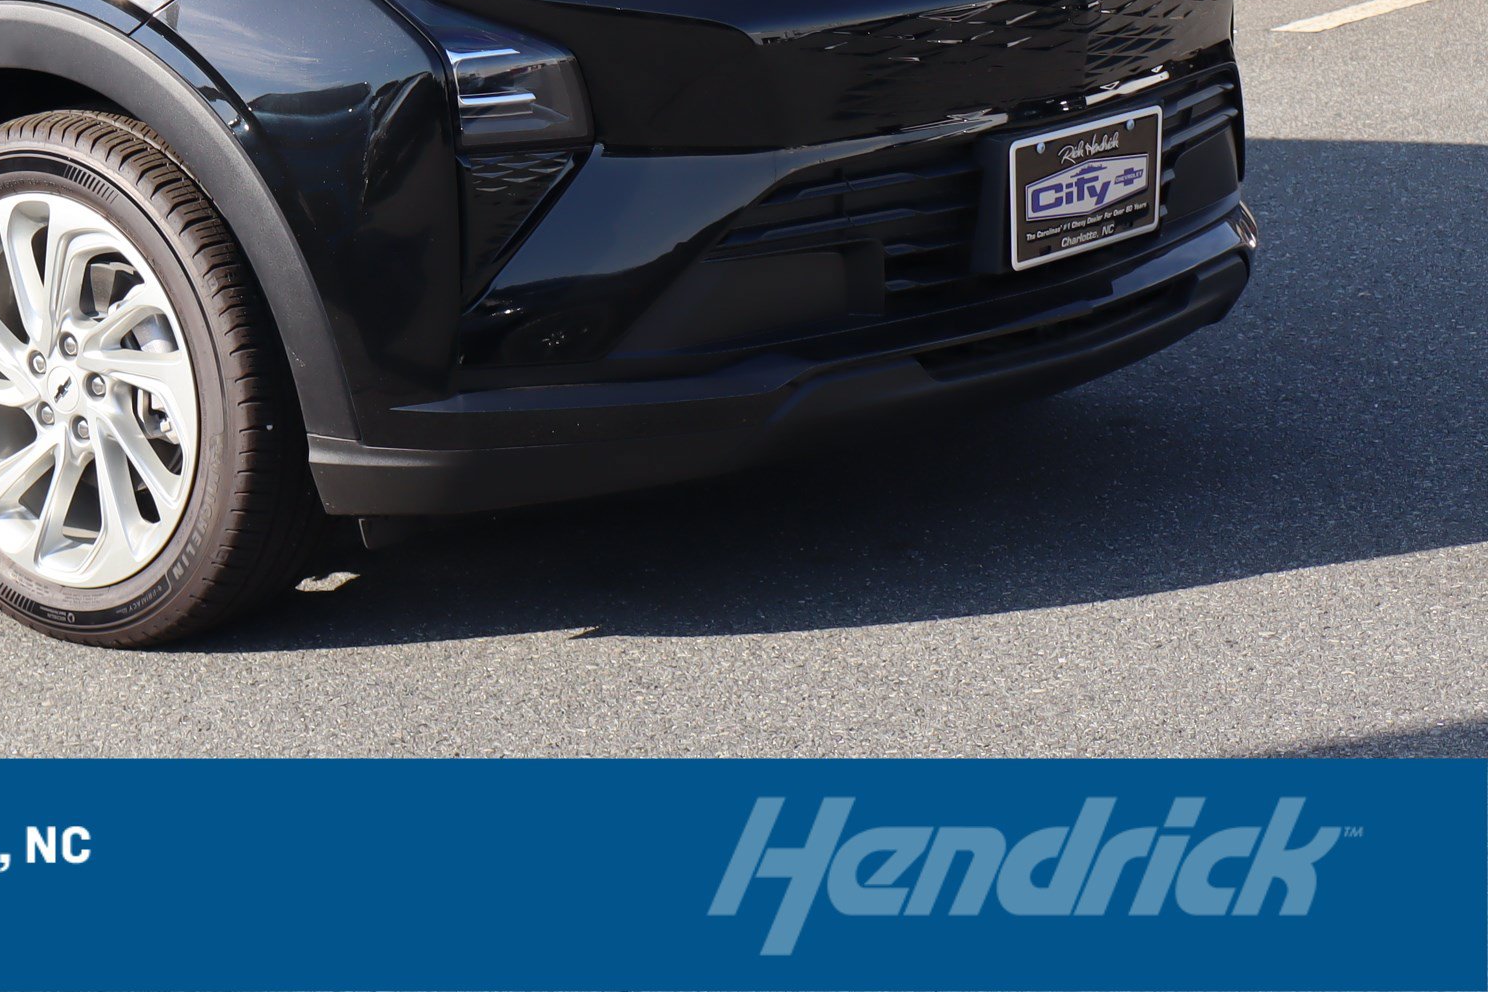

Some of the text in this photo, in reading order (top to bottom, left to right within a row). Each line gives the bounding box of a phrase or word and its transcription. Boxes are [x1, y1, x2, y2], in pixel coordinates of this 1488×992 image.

[1058, 140, 1084, 164] Rick
[1031, 175, 1112, 214] City
[1061, 223, 1115, 248] Charlotte, NC
